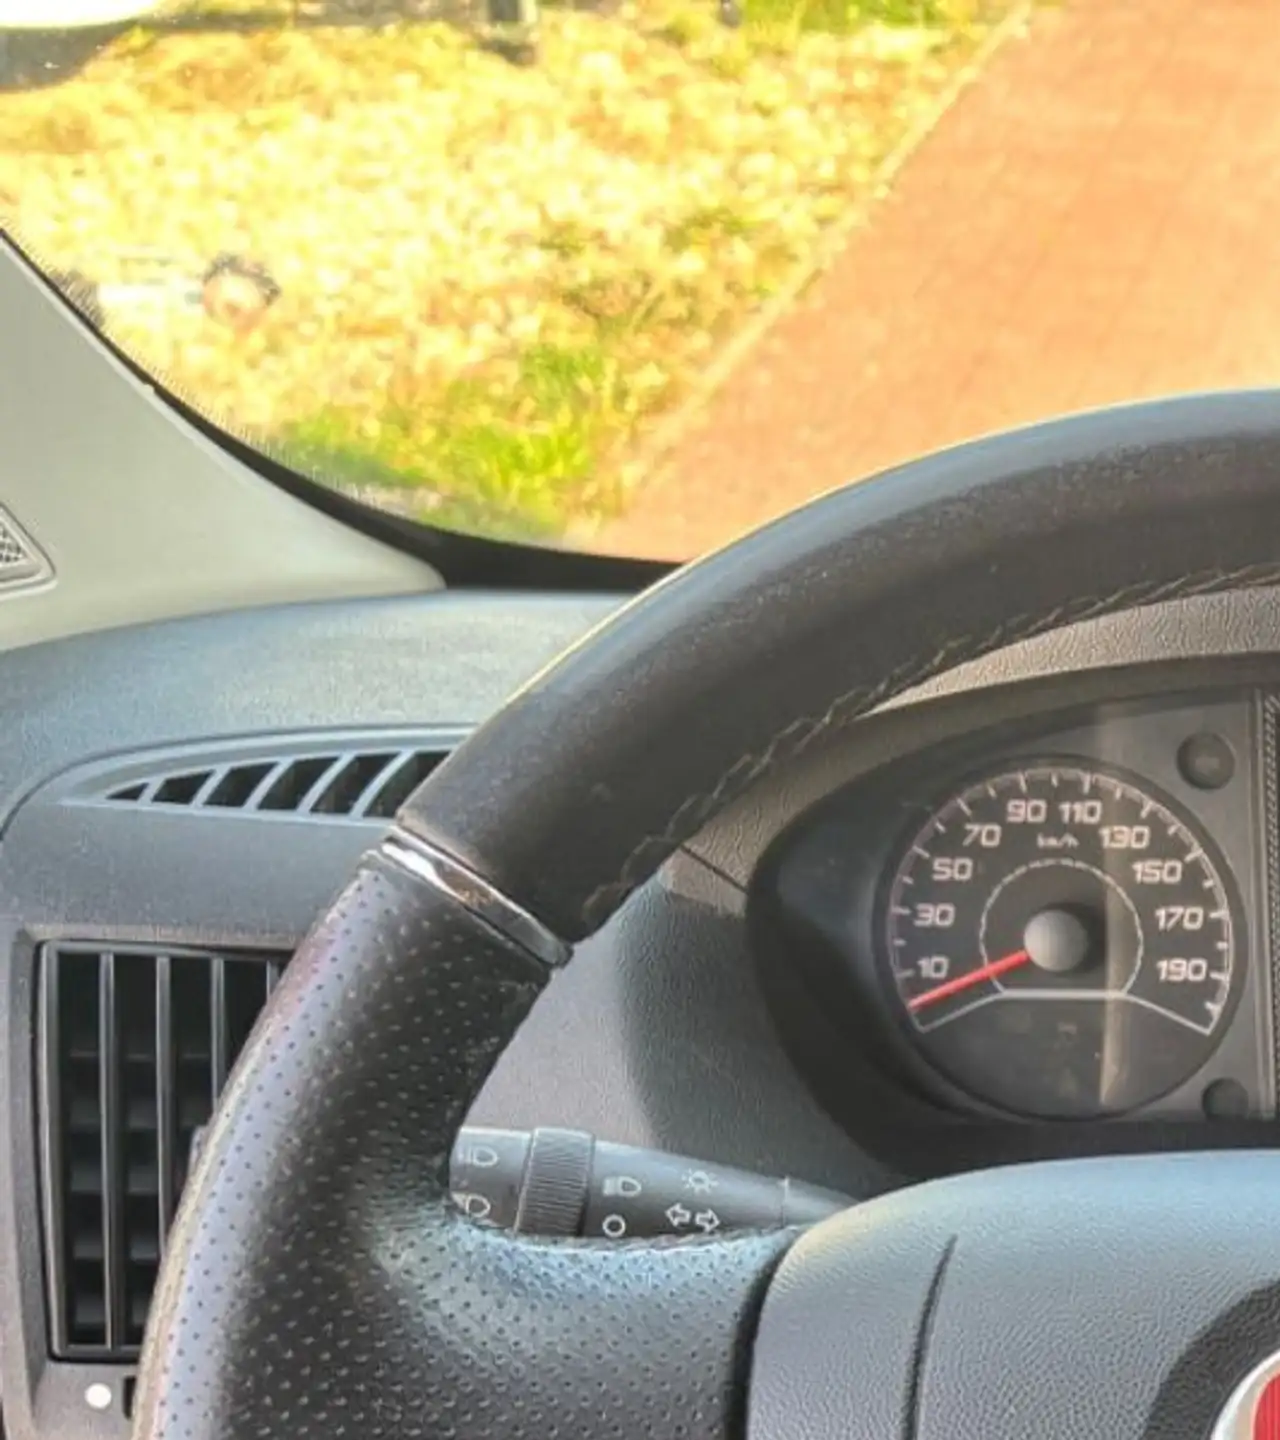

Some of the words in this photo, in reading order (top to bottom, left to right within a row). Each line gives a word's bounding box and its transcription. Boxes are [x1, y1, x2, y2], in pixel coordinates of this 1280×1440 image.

[1007, 801, 1046, 823] 90
[1059, 801, 1101, 823] 110
[963, 824, 1001, 848] 70
[1100, 825, 1150, 849] 130
[933, 857, 973, 882] 50
[1132, 860, 1182, 884] 150
[914, 903, 955, 928] 30
[1155, 907, 1204, 931] 170
[918, 956, 949, 979] 10
[1157, 958, 1207, 982] 190
